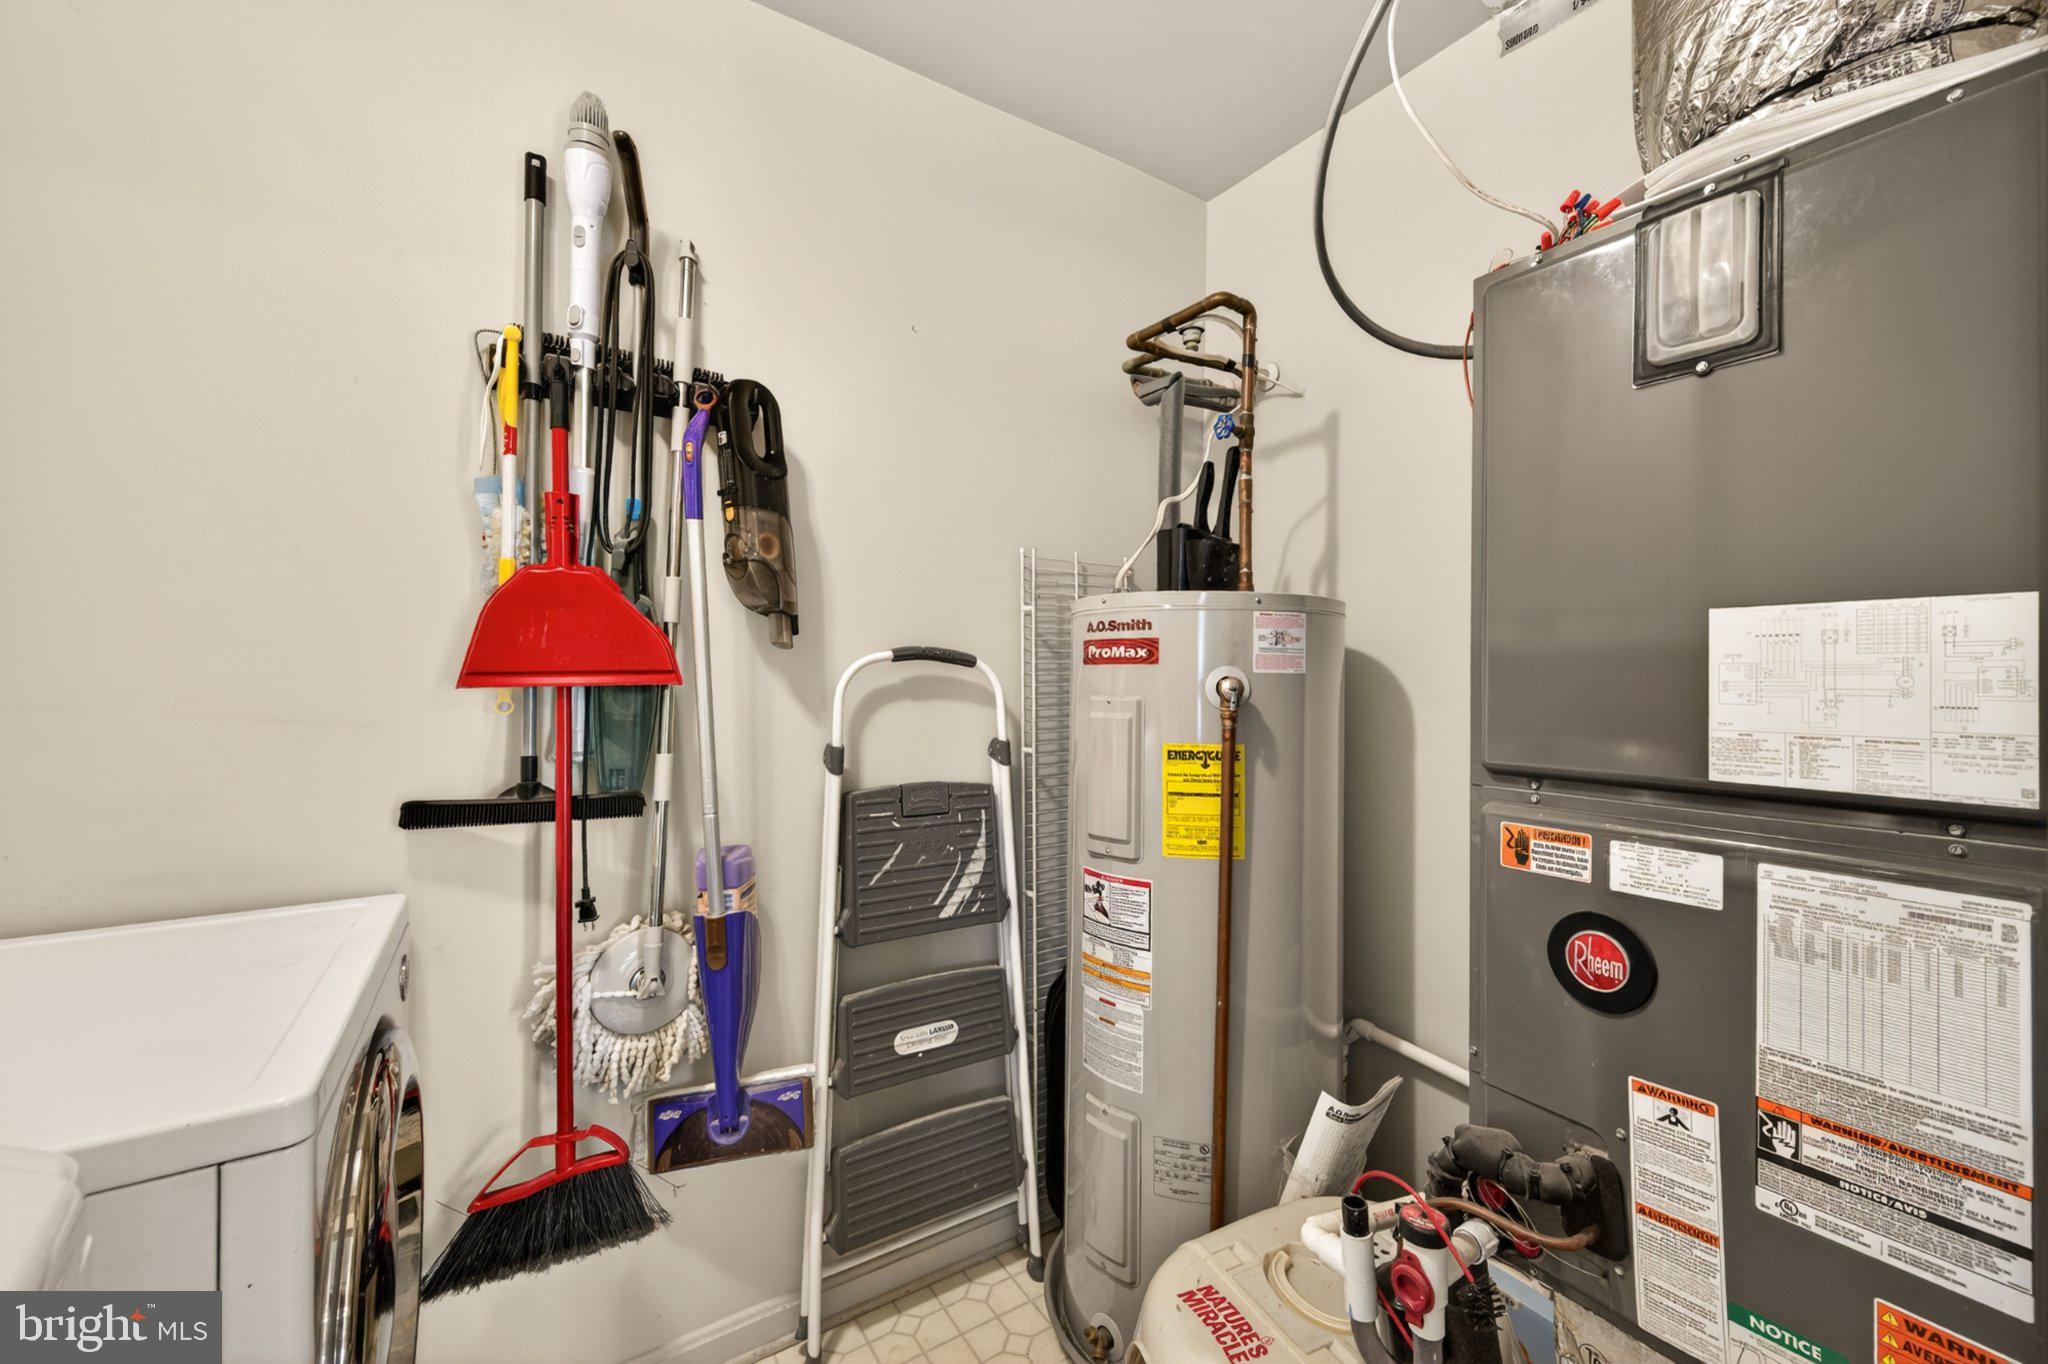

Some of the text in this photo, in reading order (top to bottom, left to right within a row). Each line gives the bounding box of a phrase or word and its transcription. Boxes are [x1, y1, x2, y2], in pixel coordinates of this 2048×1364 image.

[1088, 644, 1149, 659] ProMax
[1573, 936, 1624, 981] Rheem
[1177, 1289, 1250, 1364] MIRACLE
[1749, 1315, 1822, 1362] NOTICE
